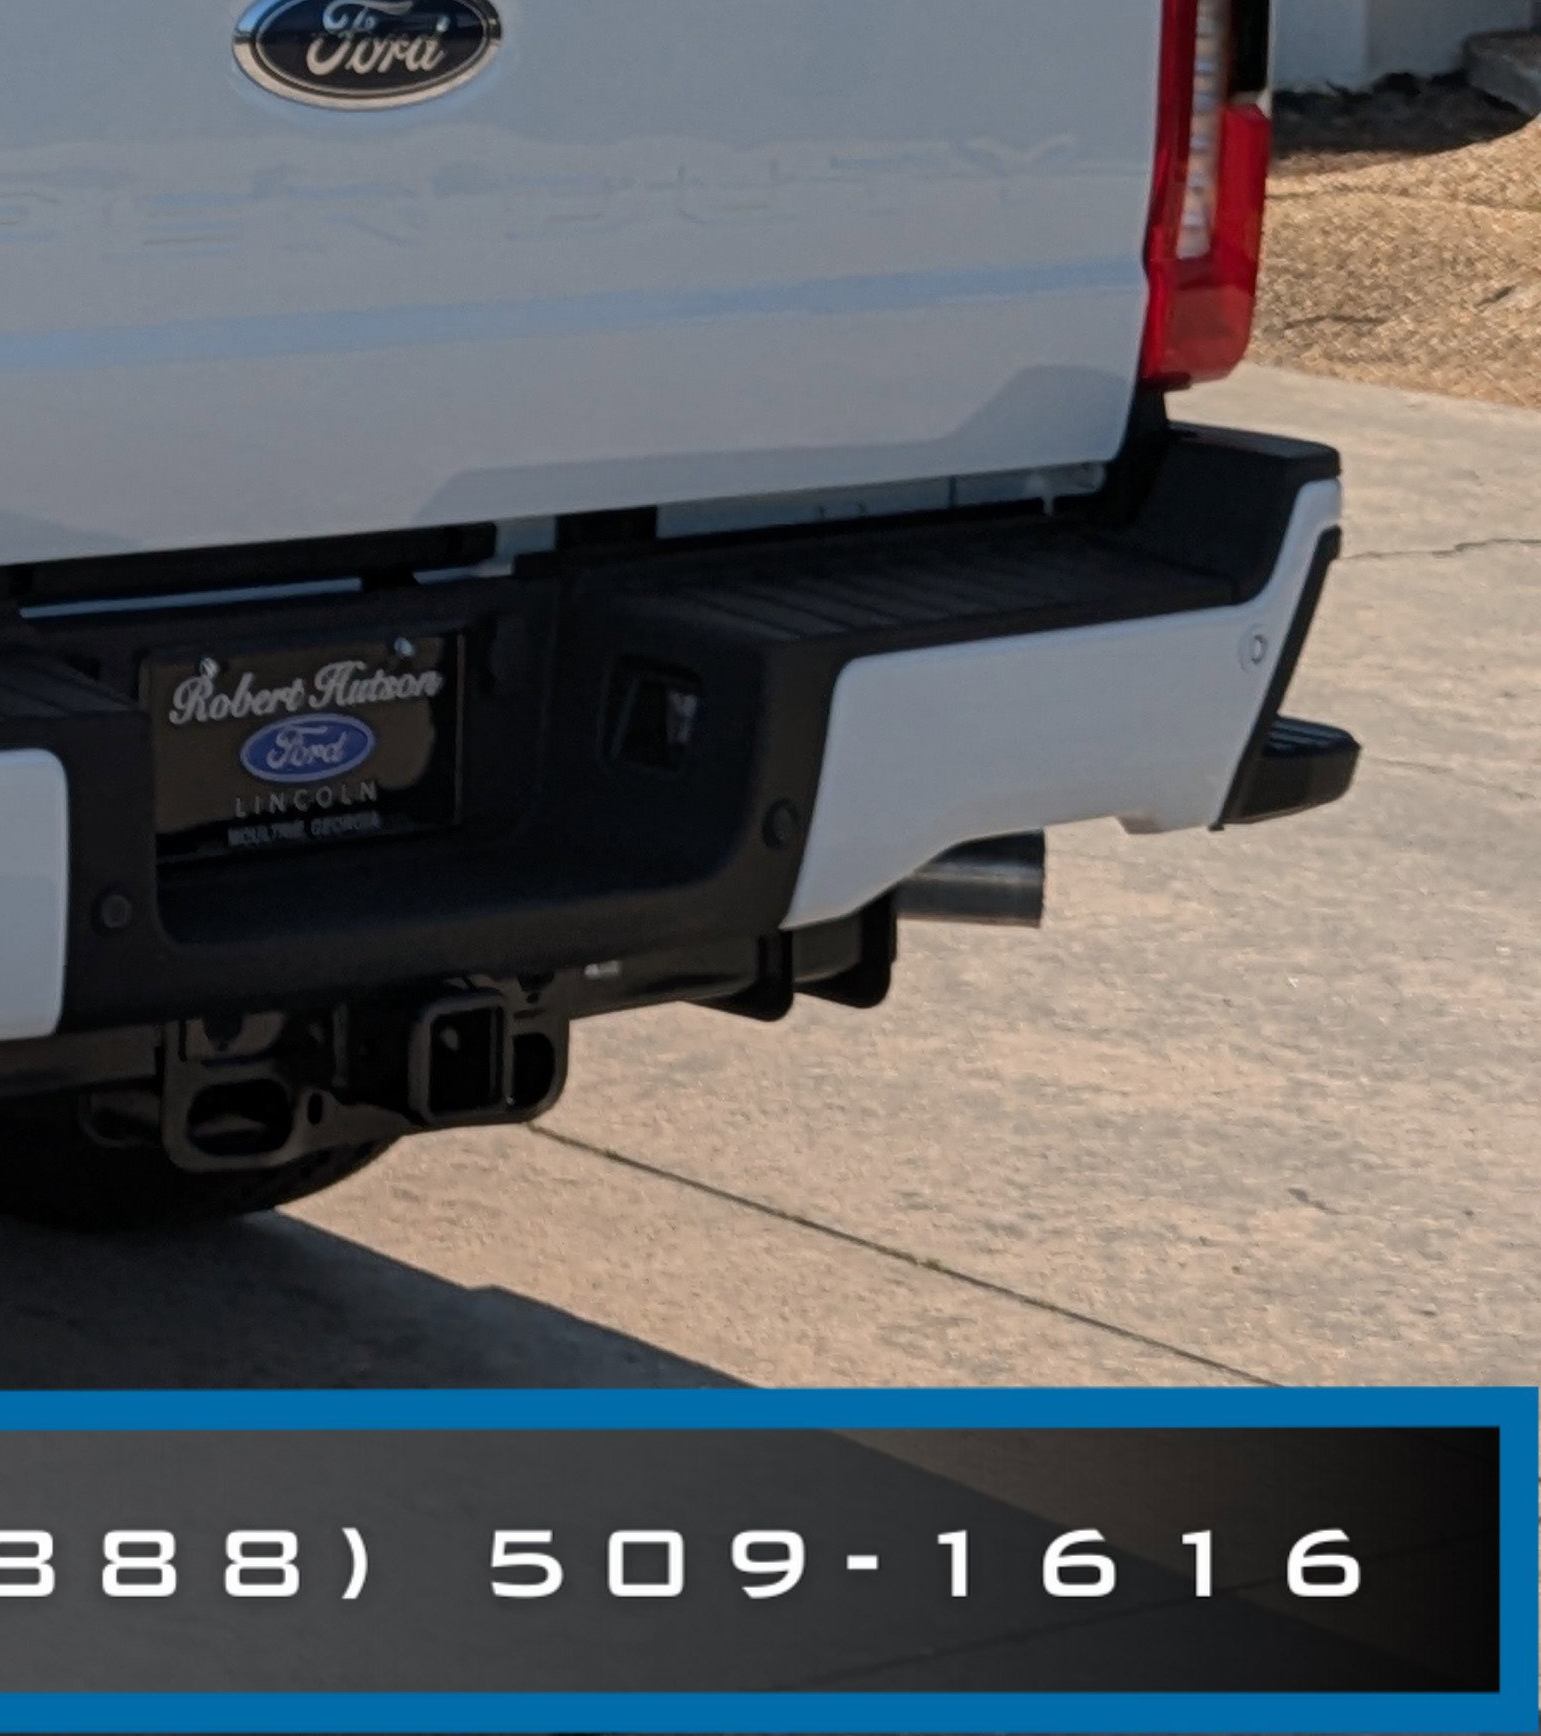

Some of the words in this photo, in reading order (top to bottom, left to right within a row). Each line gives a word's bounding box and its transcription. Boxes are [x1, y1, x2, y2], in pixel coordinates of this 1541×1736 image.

[168, 671, 305, 725] Robert
[308, 660, 443, 708] Hutson
[267, 723, 348, 769] Ford
[235, 780, 378, 818] LINCOLN
